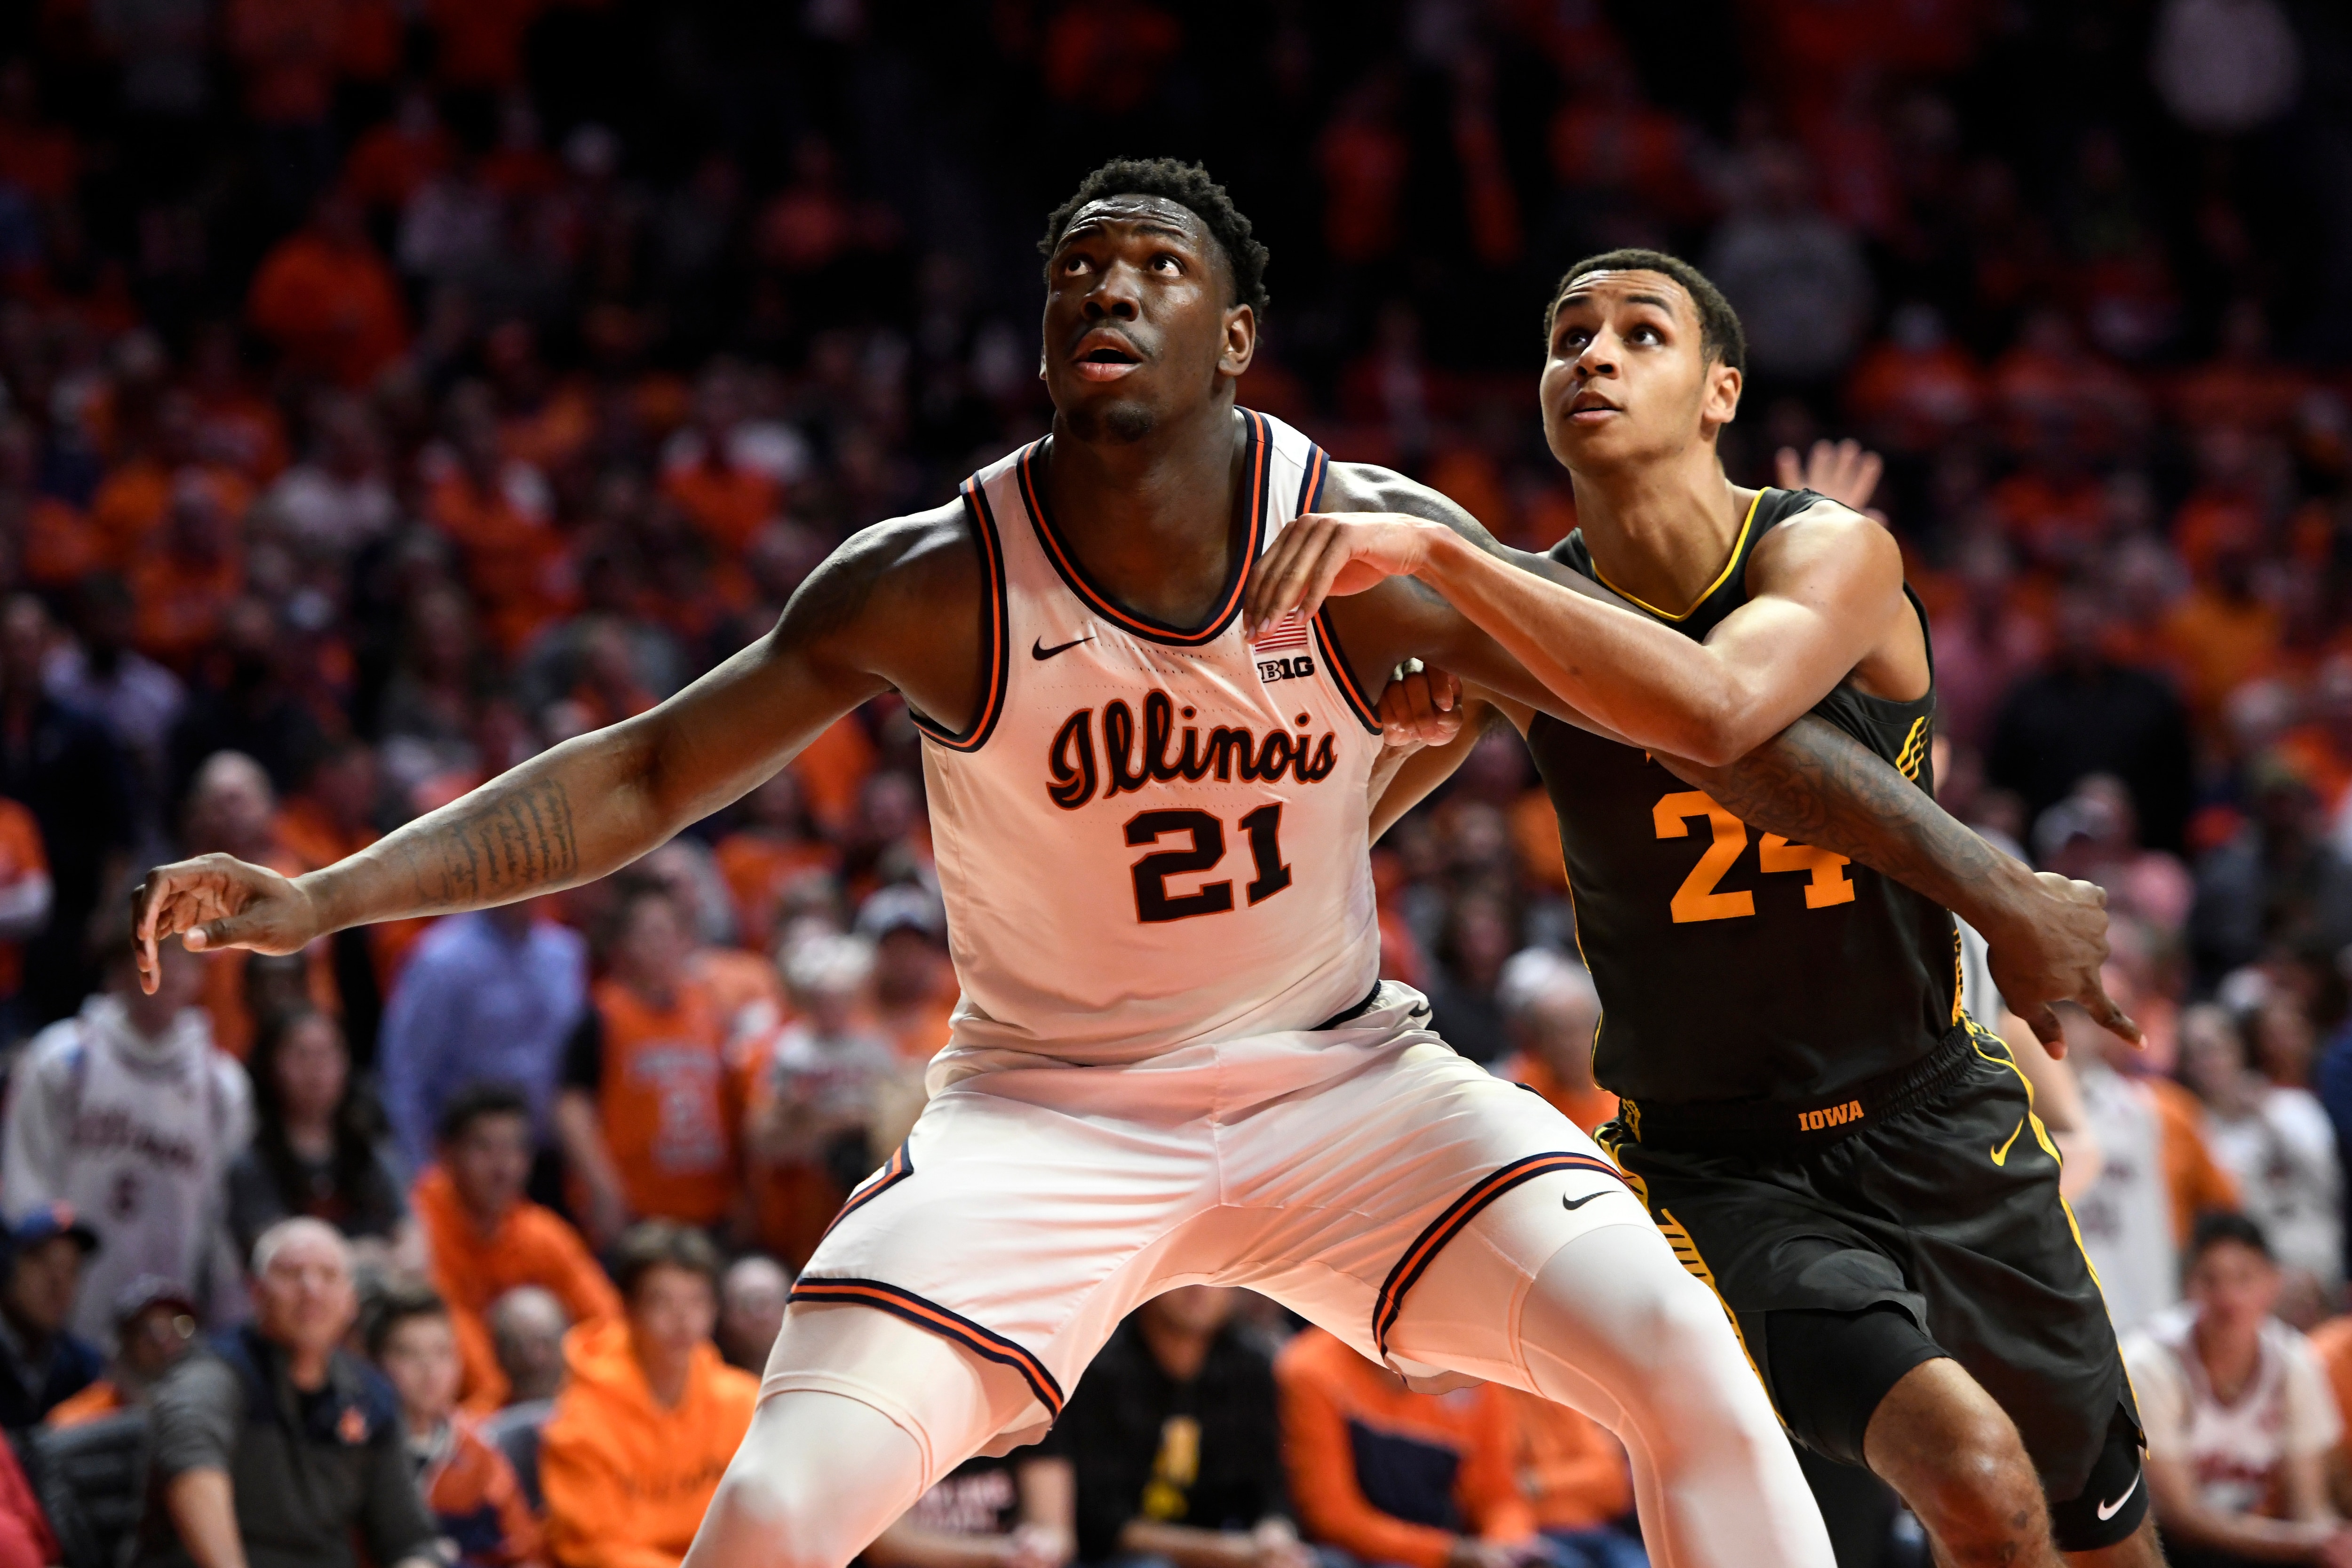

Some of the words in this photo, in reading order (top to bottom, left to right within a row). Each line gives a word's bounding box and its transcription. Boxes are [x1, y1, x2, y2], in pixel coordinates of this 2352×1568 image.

[1046, 688, 1337, 810] Illinois
[1122, 801, 1292, 923] 21
[1798, 1100, 1865, 1131] IOWA
